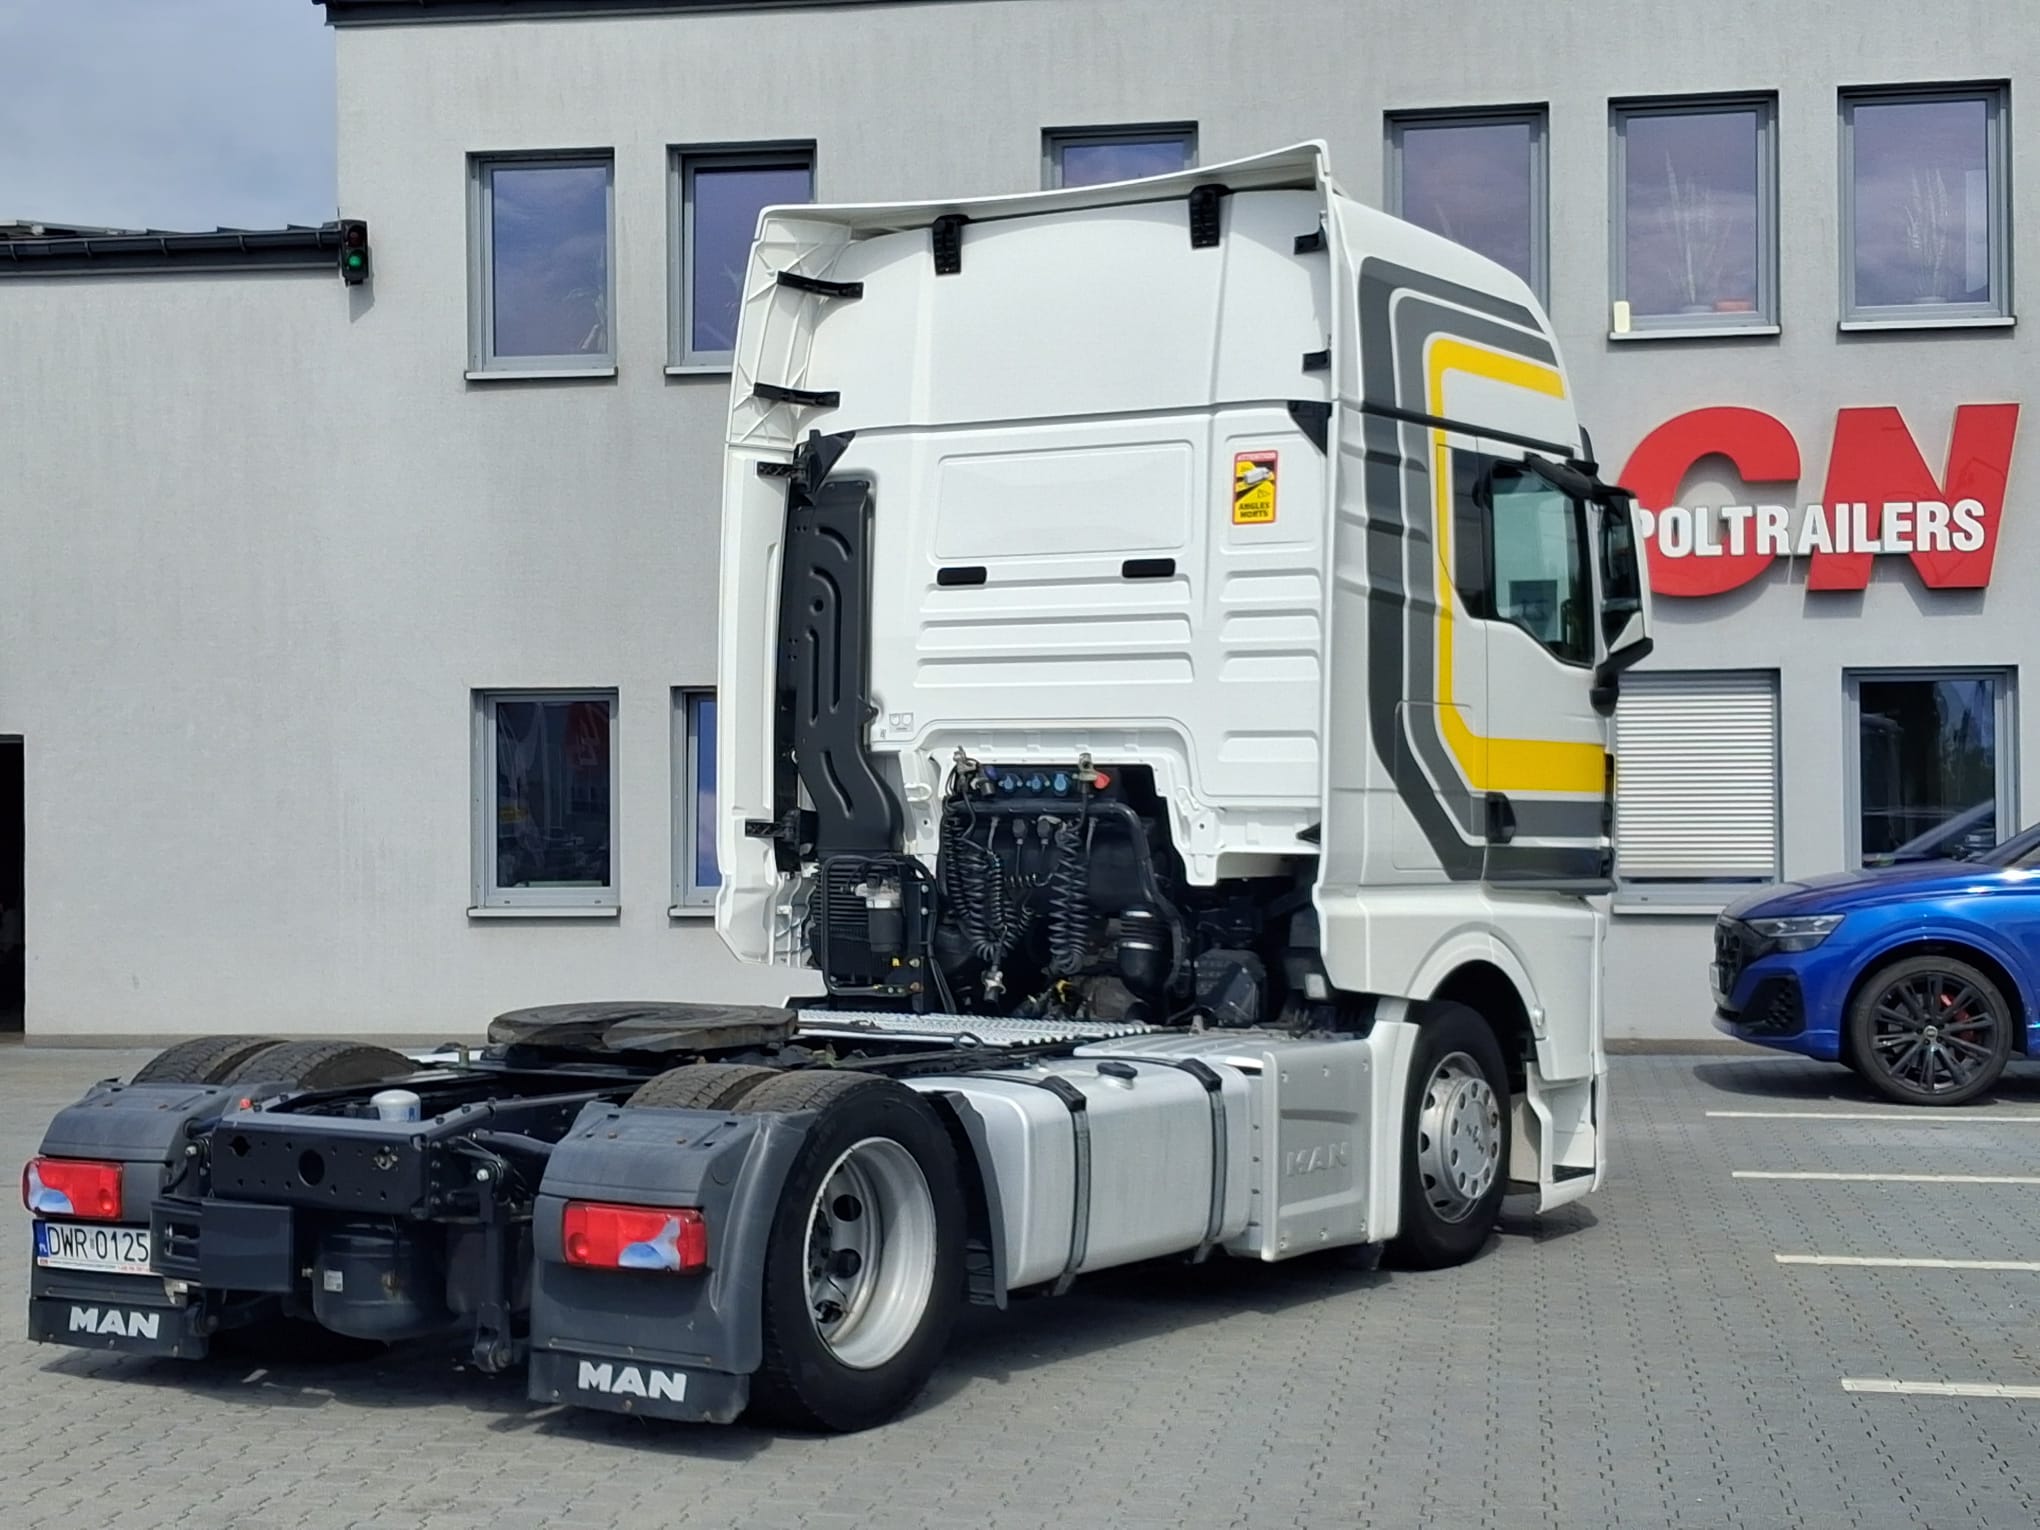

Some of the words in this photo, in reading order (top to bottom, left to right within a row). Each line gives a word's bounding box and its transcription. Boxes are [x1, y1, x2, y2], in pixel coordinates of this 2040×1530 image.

[47, 1226, 88, 1259] DWR
[69, 1305, 160, 1340] MAN
[578, 1360, 687, 1403] MAN
